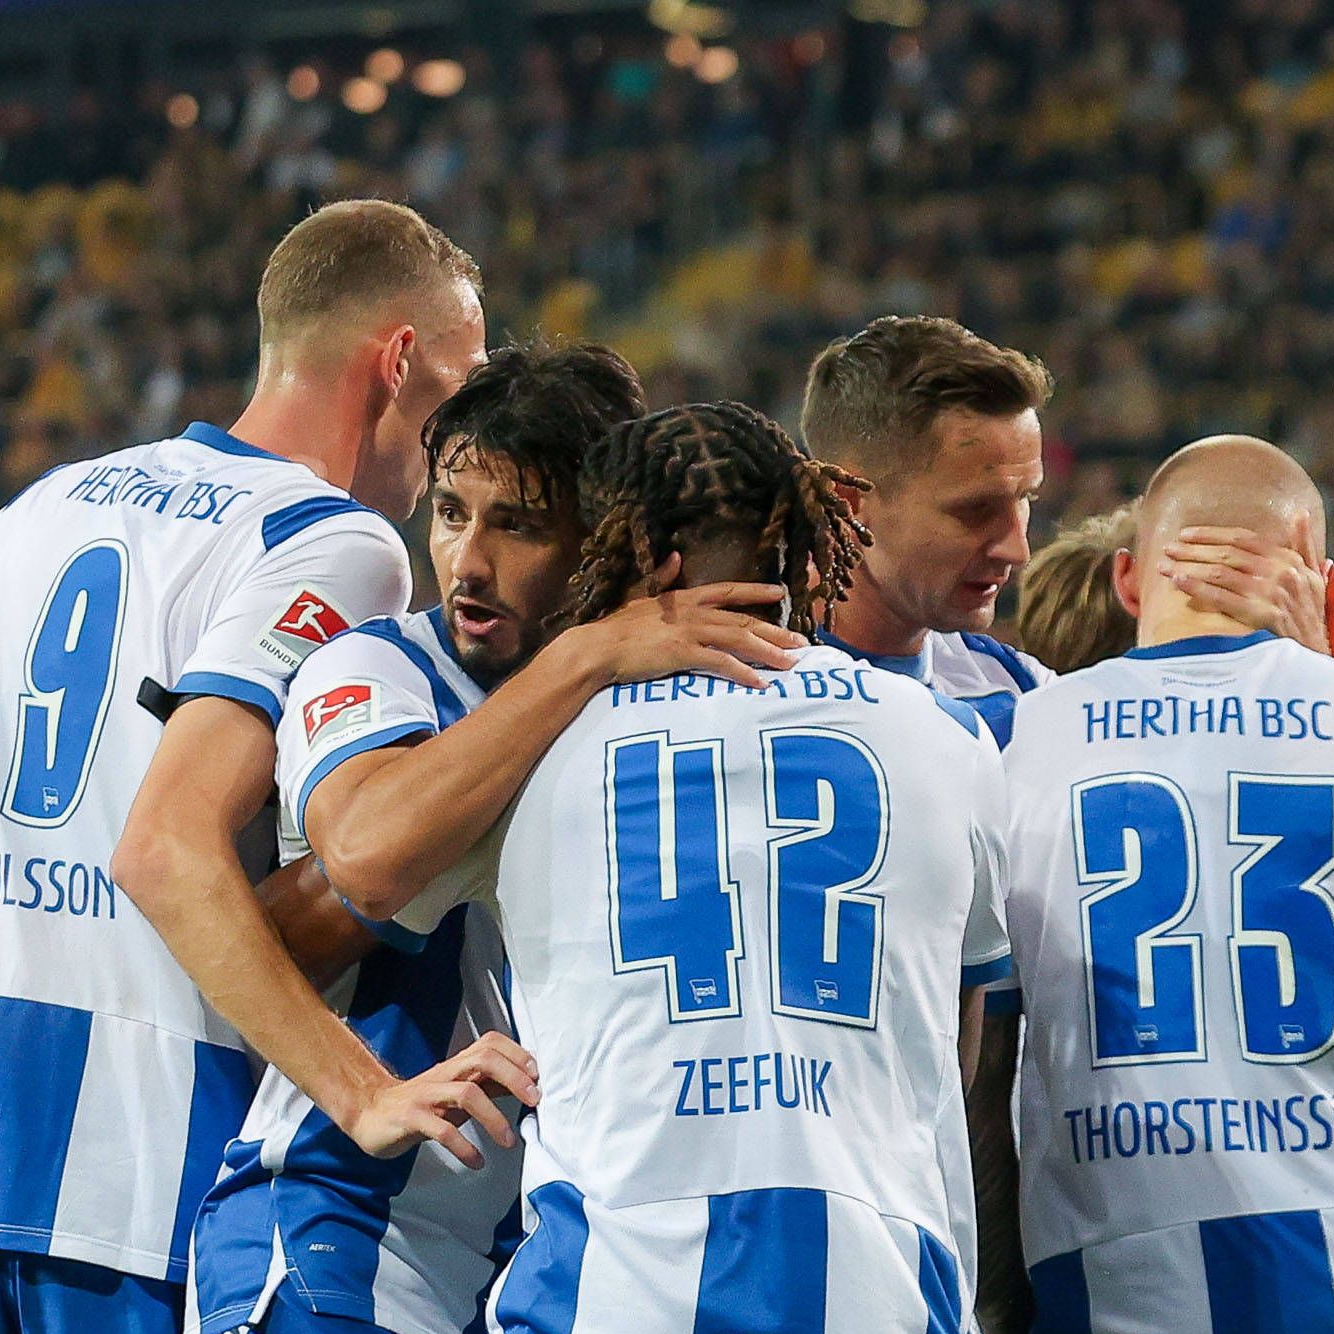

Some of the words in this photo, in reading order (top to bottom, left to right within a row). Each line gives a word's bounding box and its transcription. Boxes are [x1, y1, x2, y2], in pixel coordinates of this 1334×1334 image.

[175, 481, 254, 525] BSC
[0, 538, 130, 829] 9
[795, 667, 879, 704] BSC
[1082, 695, 1245, 743] HERTHA
[1255, 697, 1333, 742] BSC
[604, 727, 891, 1030] 42
[673, 1053, 835, 1118] ZEEFUIK
